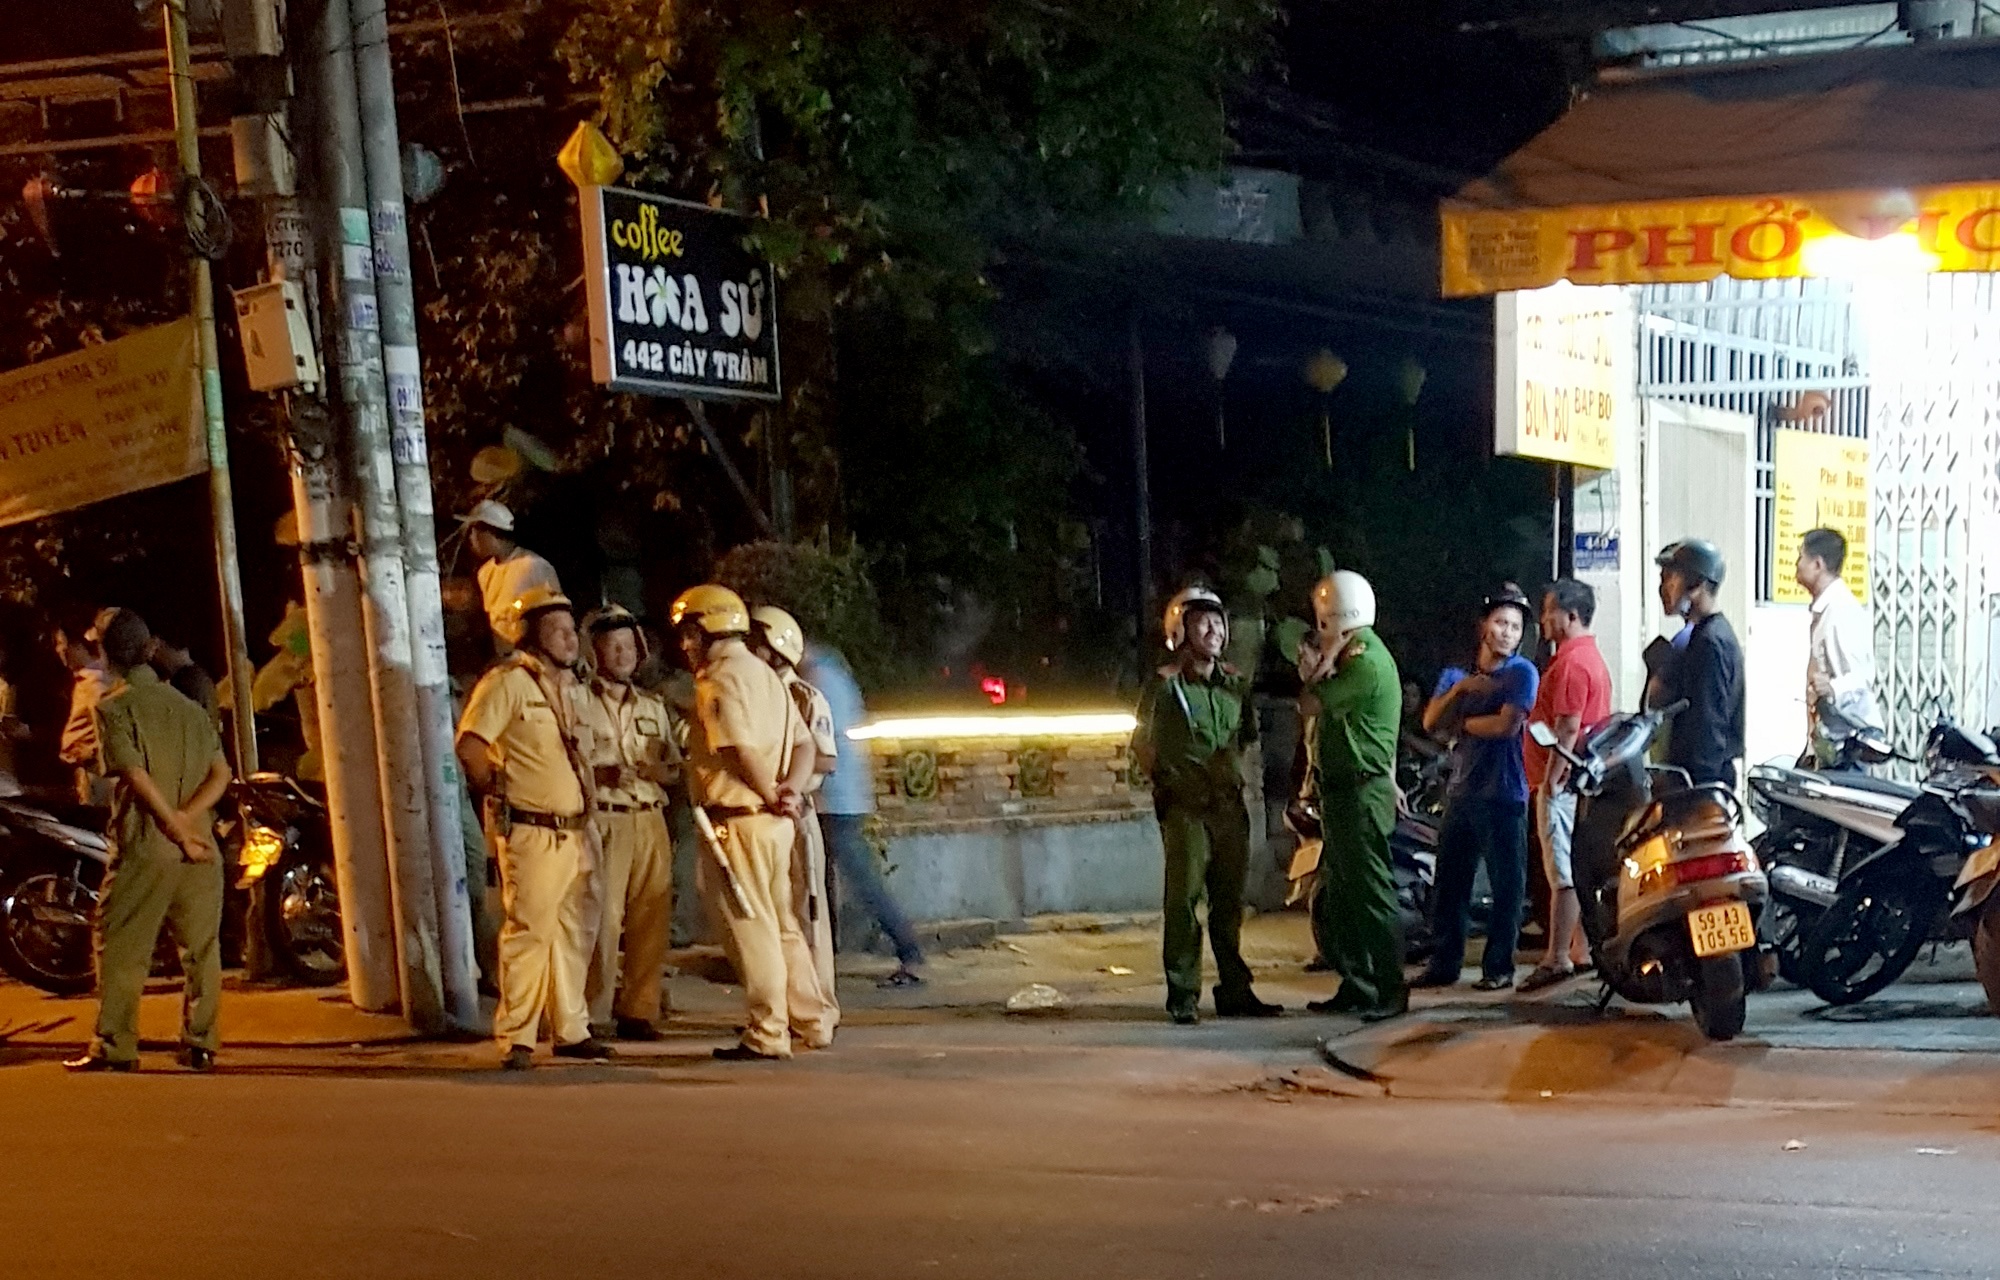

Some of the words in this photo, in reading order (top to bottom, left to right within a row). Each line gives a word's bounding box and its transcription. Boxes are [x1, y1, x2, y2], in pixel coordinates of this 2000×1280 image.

[612, 203, 684, 261] coffee
[1567, 198, 1811, 272] PHỞ
[623, 339, 664, 372] 442
[669, 340, 708, 377] CÂY
